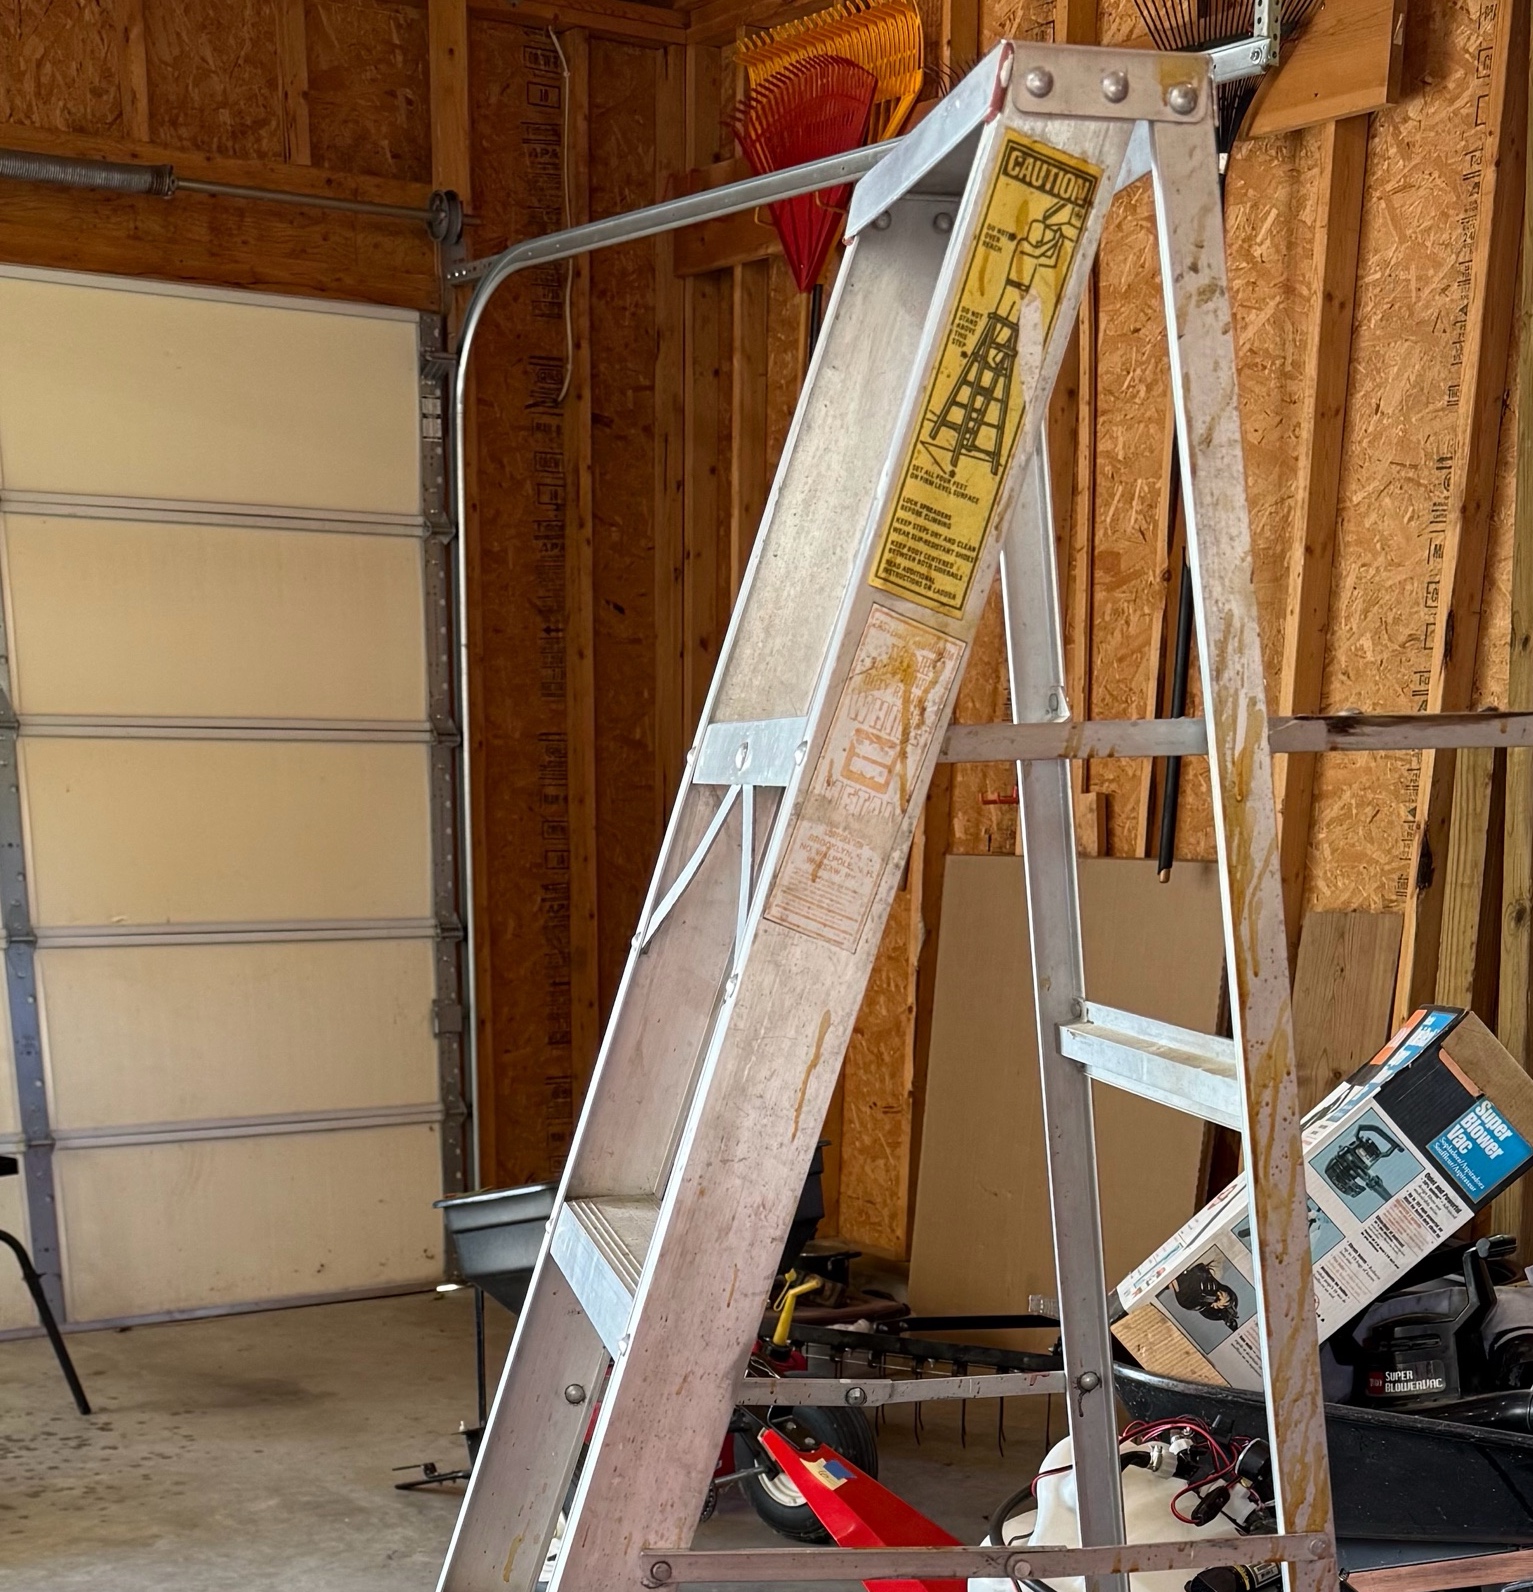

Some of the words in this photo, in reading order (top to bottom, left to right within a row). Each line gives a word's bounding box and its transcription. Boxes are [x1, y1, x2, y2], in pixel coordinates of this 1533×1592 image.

[1006, 150, 1090, 204] CAUTION
[981, 239, 1002, 254] REACH
[984, 231, 1000, 244] OVER
[958, 314, 978, 327] STAND
[960, 306, 970, 315] DO
[970, 310, 983, 320] NOT
[954, 330, 967, 340] THIS
[955, 321, 976, 335] ABOVE
[951, 337, 966, 349] STEP
[910, 472, 918, 480] ON
[919, 476, 934, 486] FIRM
[934, 482, 951, 493] LEVEL
[953, 490, 979, 504] SURFACE
[912, 464, 923, 473] SET
[924, 469, 934, 477] ALL
[935, 474, 951, 484] FOUR
[952, 480, 967, 491] FEET
[900, 504, 922, 517] BEFORE
[924, 514, 951, 529] CLIMBING
[902, 496, 918, 506] LOCK
[919, 503, 951, 520] SPREADERS
[892, 526, 910, 537] WEAR
[910, 534, 954, 555] SLIP-RESISTANT
[955, 551, 974, 563] SHOES
[895, 516, 911, 527] KEEP
[912, 523, 929, 534] STEPS
[930, 530, 942, 539] DRY
[943, 535, 956, 545] AND
[957, 541, 975, 553] CLEAN
[888, 547, 916, 562] BETWEEN
[917, 559, 932, 569] BOTH
[933, 565, 962, 581] SIDERAILS
[890, 539, 905, 550] KEEP
[907, 546, 922, 556] BODY
[924, 553, 954, 569] CENTERED
[882, 567, 922, 587] INSTRUCTIONS
[932, 587, 956, 600] LADDER
[885, 559, 900, 569] READ
[901, 566, 935, 584] ADDITIONAL
[1475, 1100, 1513, 1141] Super
[1446, 1124, 1473, 1154] Vac
[1460, 1112, 1505, 1160] Blower
[1385, 1370, 1413, 1381] SUPER
[1385, 1378, 1443, 1393] BLOWERVAC
